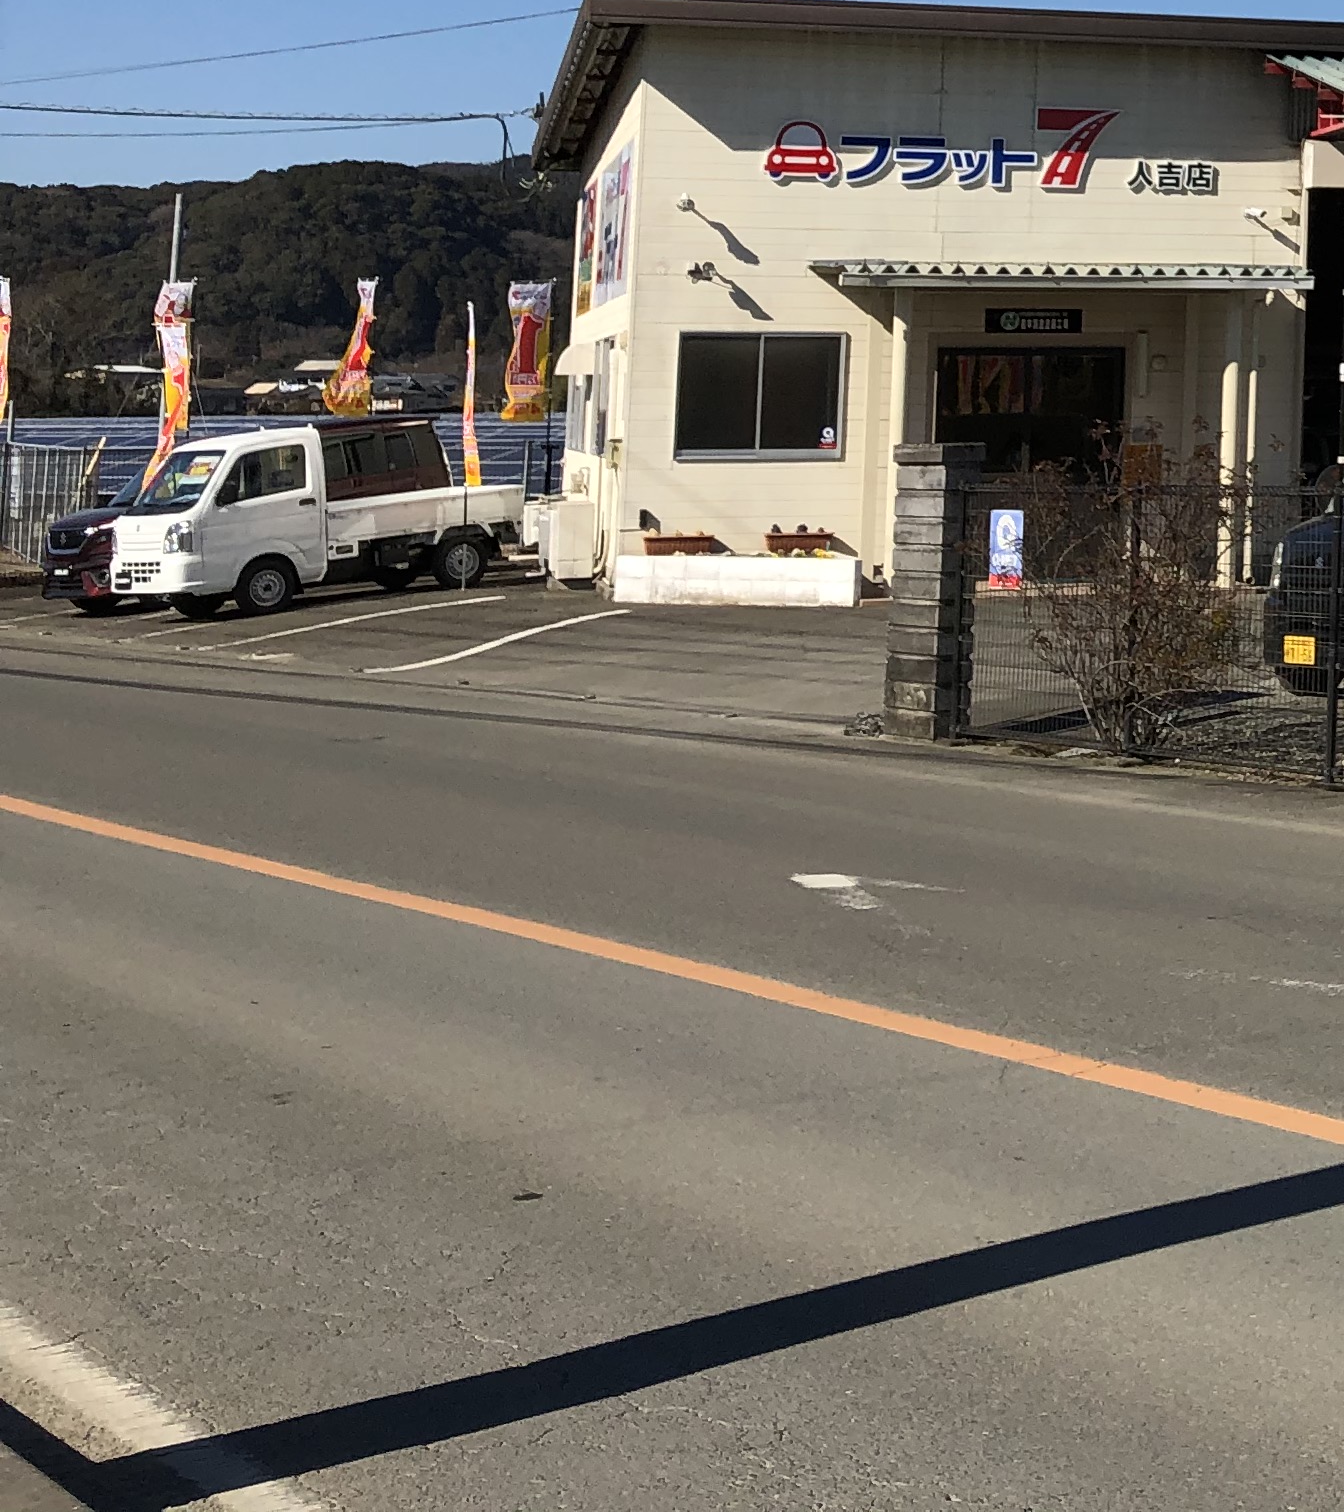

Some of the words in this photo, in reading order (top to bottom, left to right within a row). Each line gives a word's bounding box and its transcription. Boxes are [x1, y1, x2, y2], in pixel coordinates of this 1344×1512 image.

[841, 108, 1120, 186] フラット7
[1128, 162, 1215, 190] 人吉店
